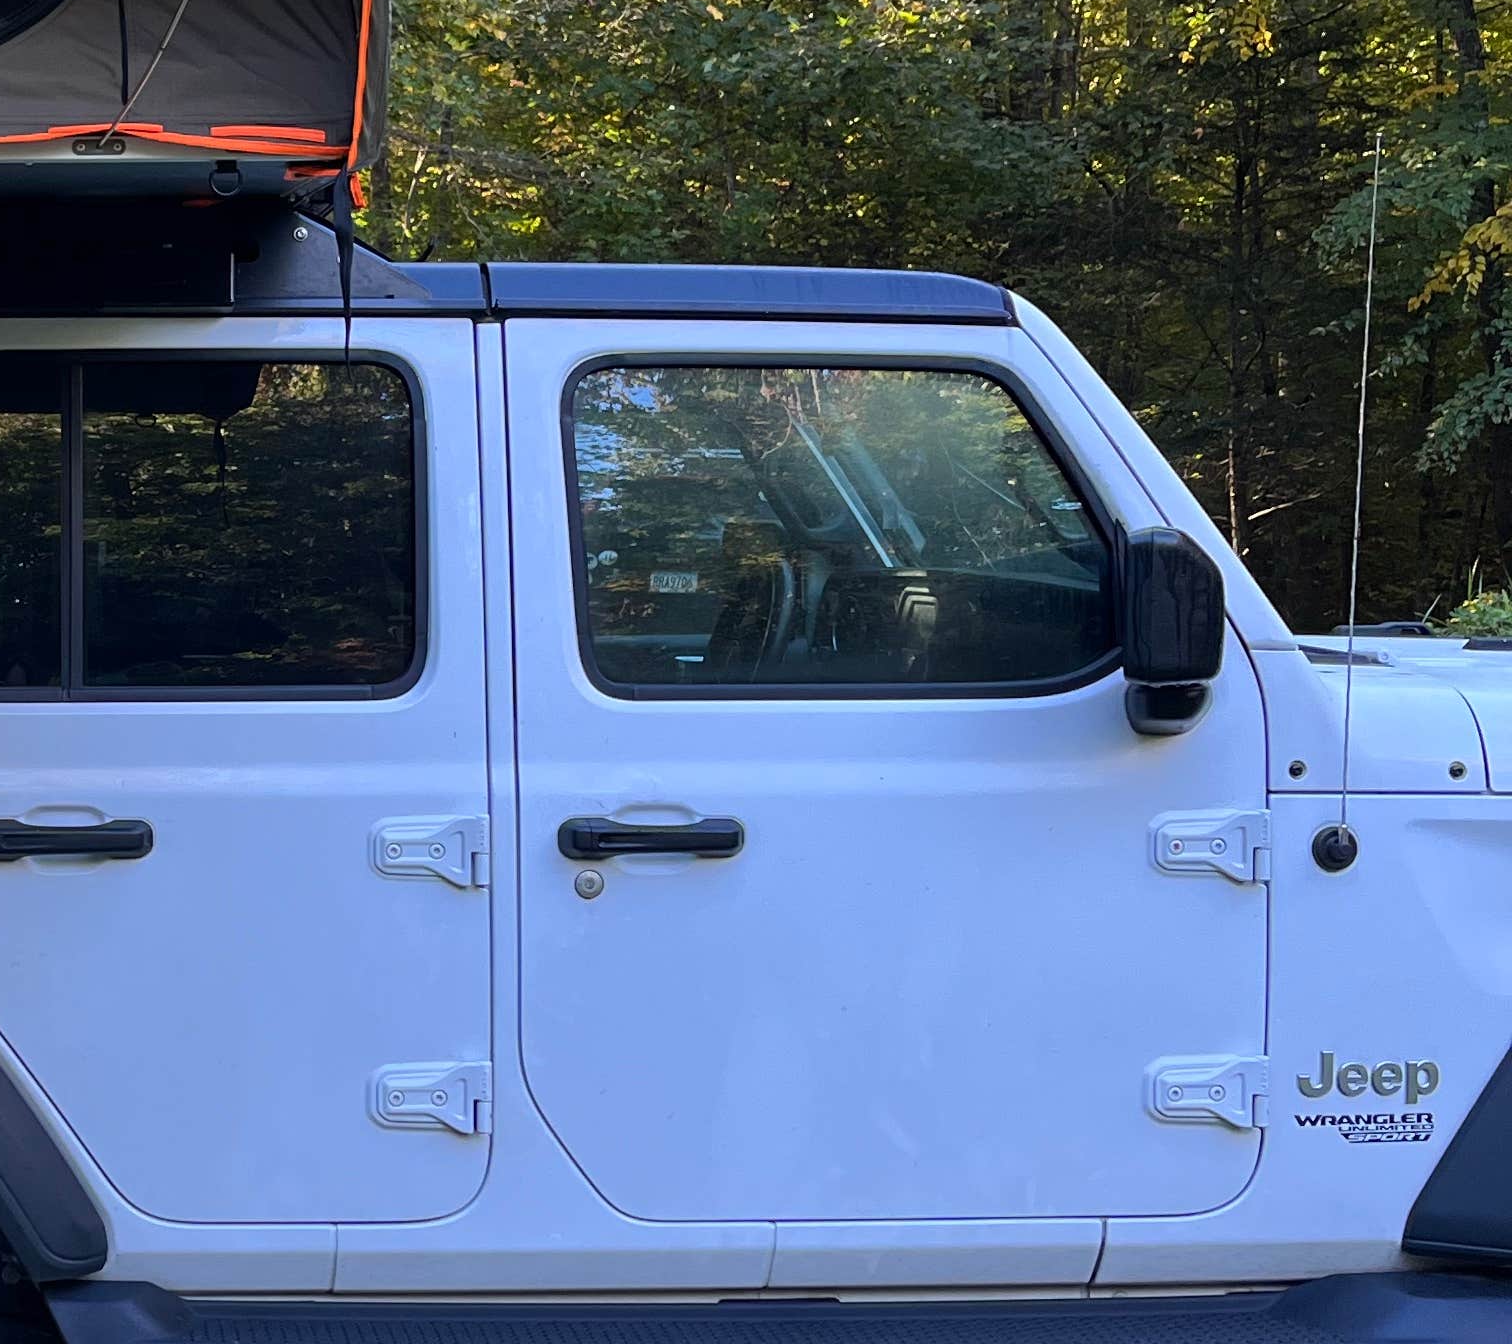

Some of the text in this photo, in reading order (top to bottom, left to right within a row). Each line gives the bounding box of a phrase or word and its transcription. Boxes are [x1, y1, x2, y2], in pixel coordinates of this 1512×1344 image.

[1296, 1049, 1439, 1104] Jeep
[1294, 1112, 1434, 1127] WRANGLER
[1338, 1124, 1435, 1132] UNLIMITED
[1345, 1132, 1431, 1142] SPORT
